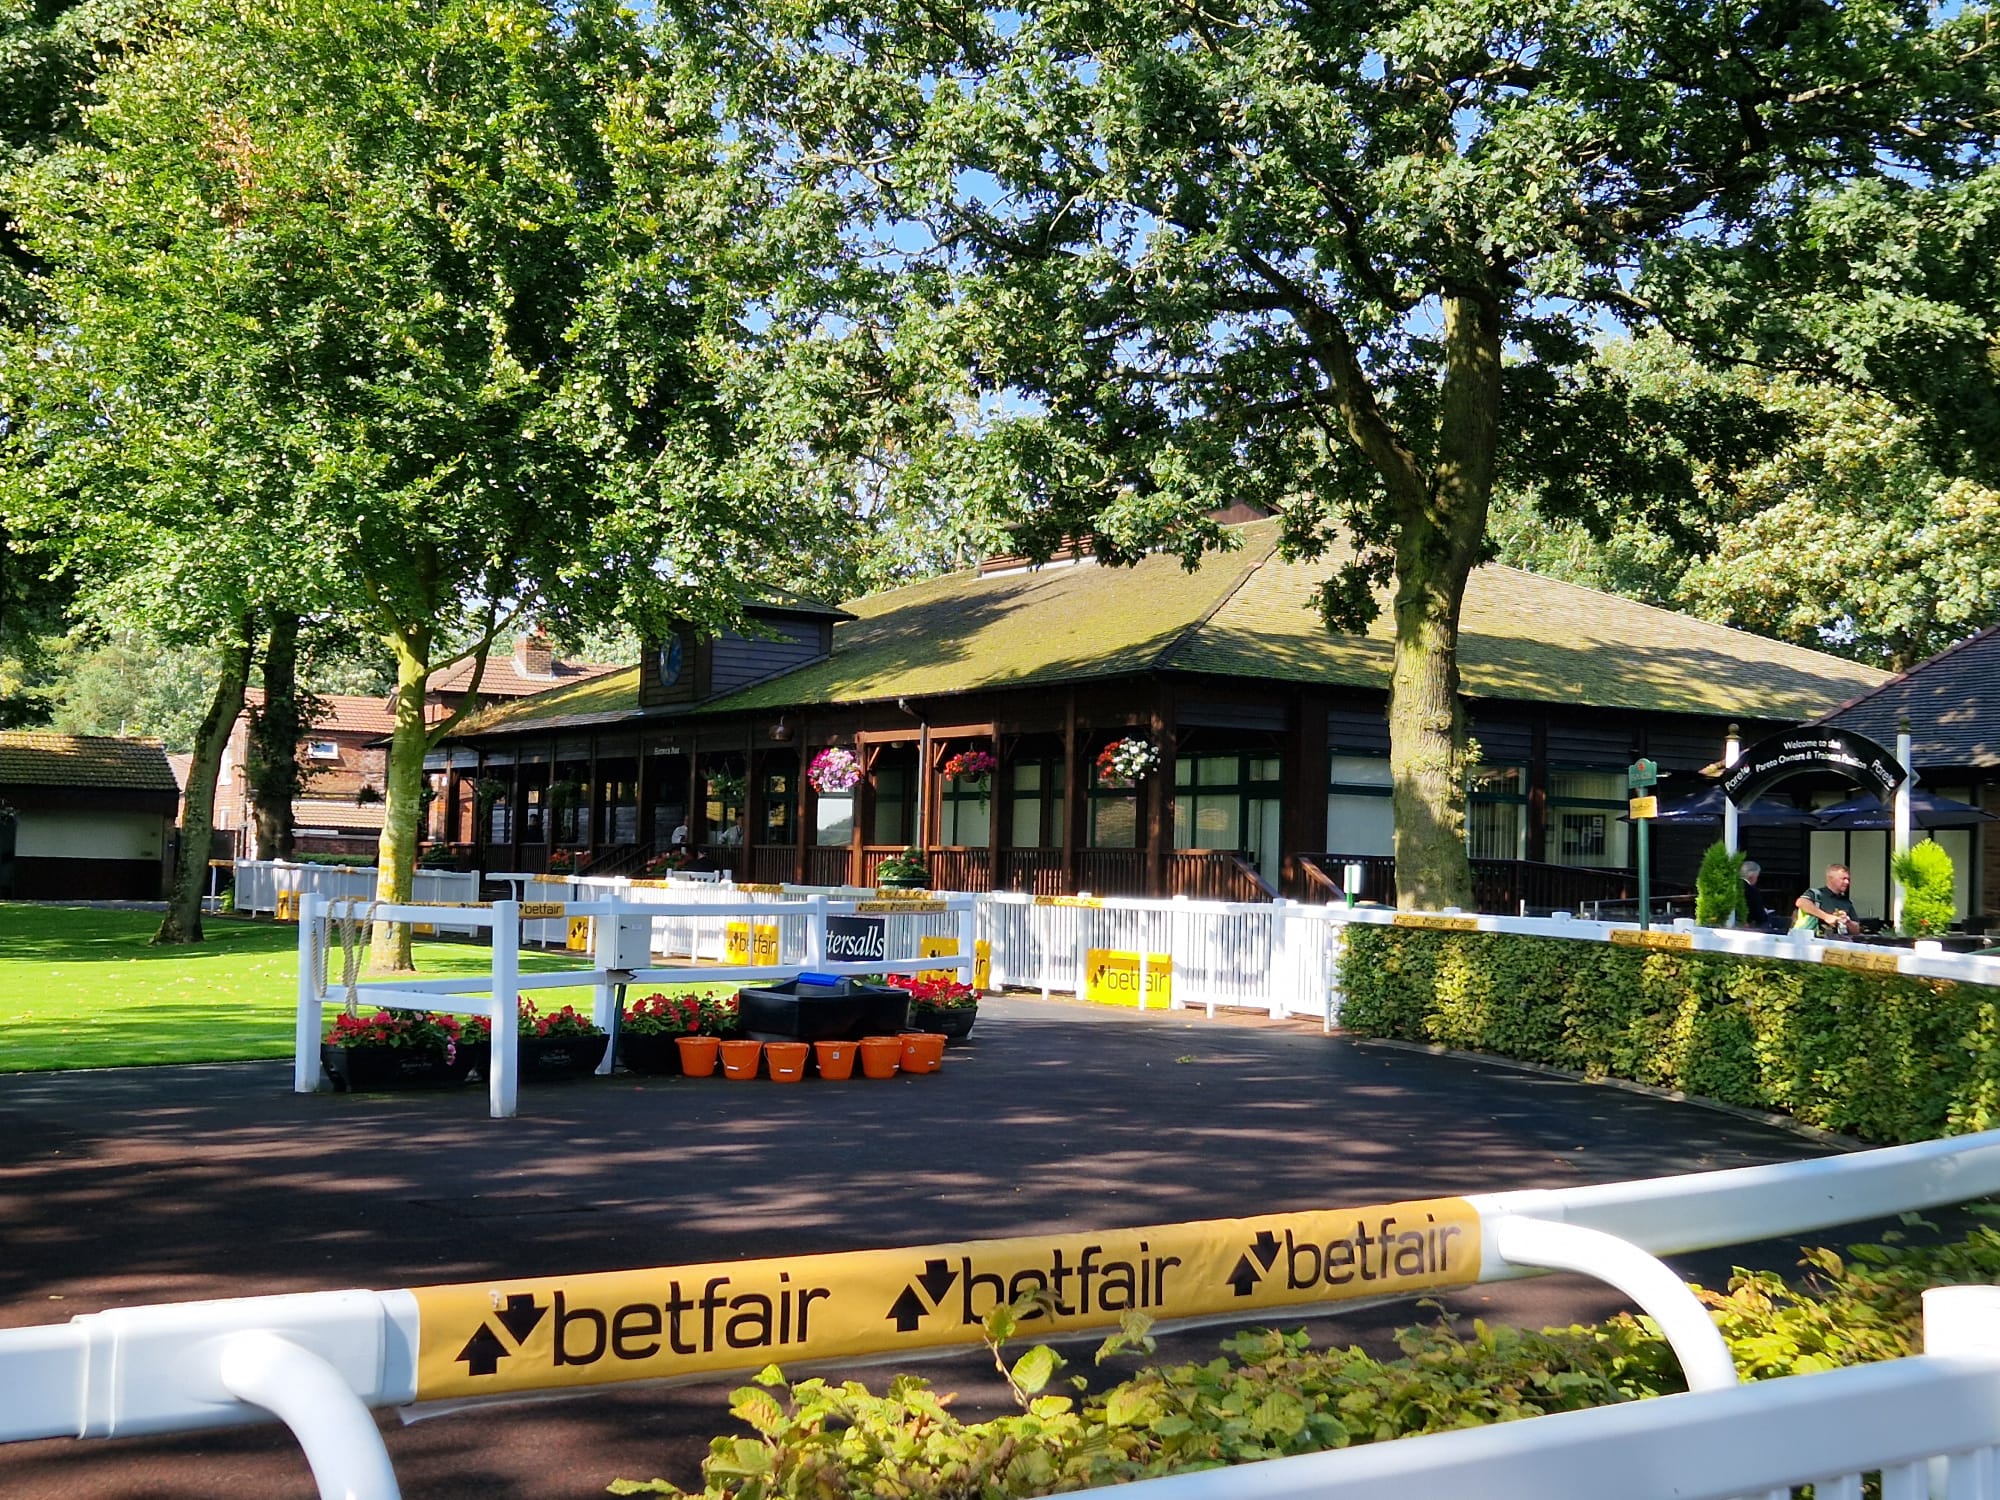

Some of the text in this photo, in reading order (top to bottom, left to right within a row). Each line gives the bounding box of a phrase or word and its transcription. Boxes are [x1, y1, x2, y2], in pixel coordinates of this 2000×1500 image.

[1783, 740, 1817, 750] Welcome
[1755, 759, 1778, 772] Pareto
[1778, 753, 1805, 764] Owners
[1806, 751, 1812, 760] &
[1813, 750, 1841, 763] Trainers
[524, 903, 561, 915] betfair
[739, 932, 777, 955] btfair
[553, 1213, 1462, 1367] betfair betfair betfair
